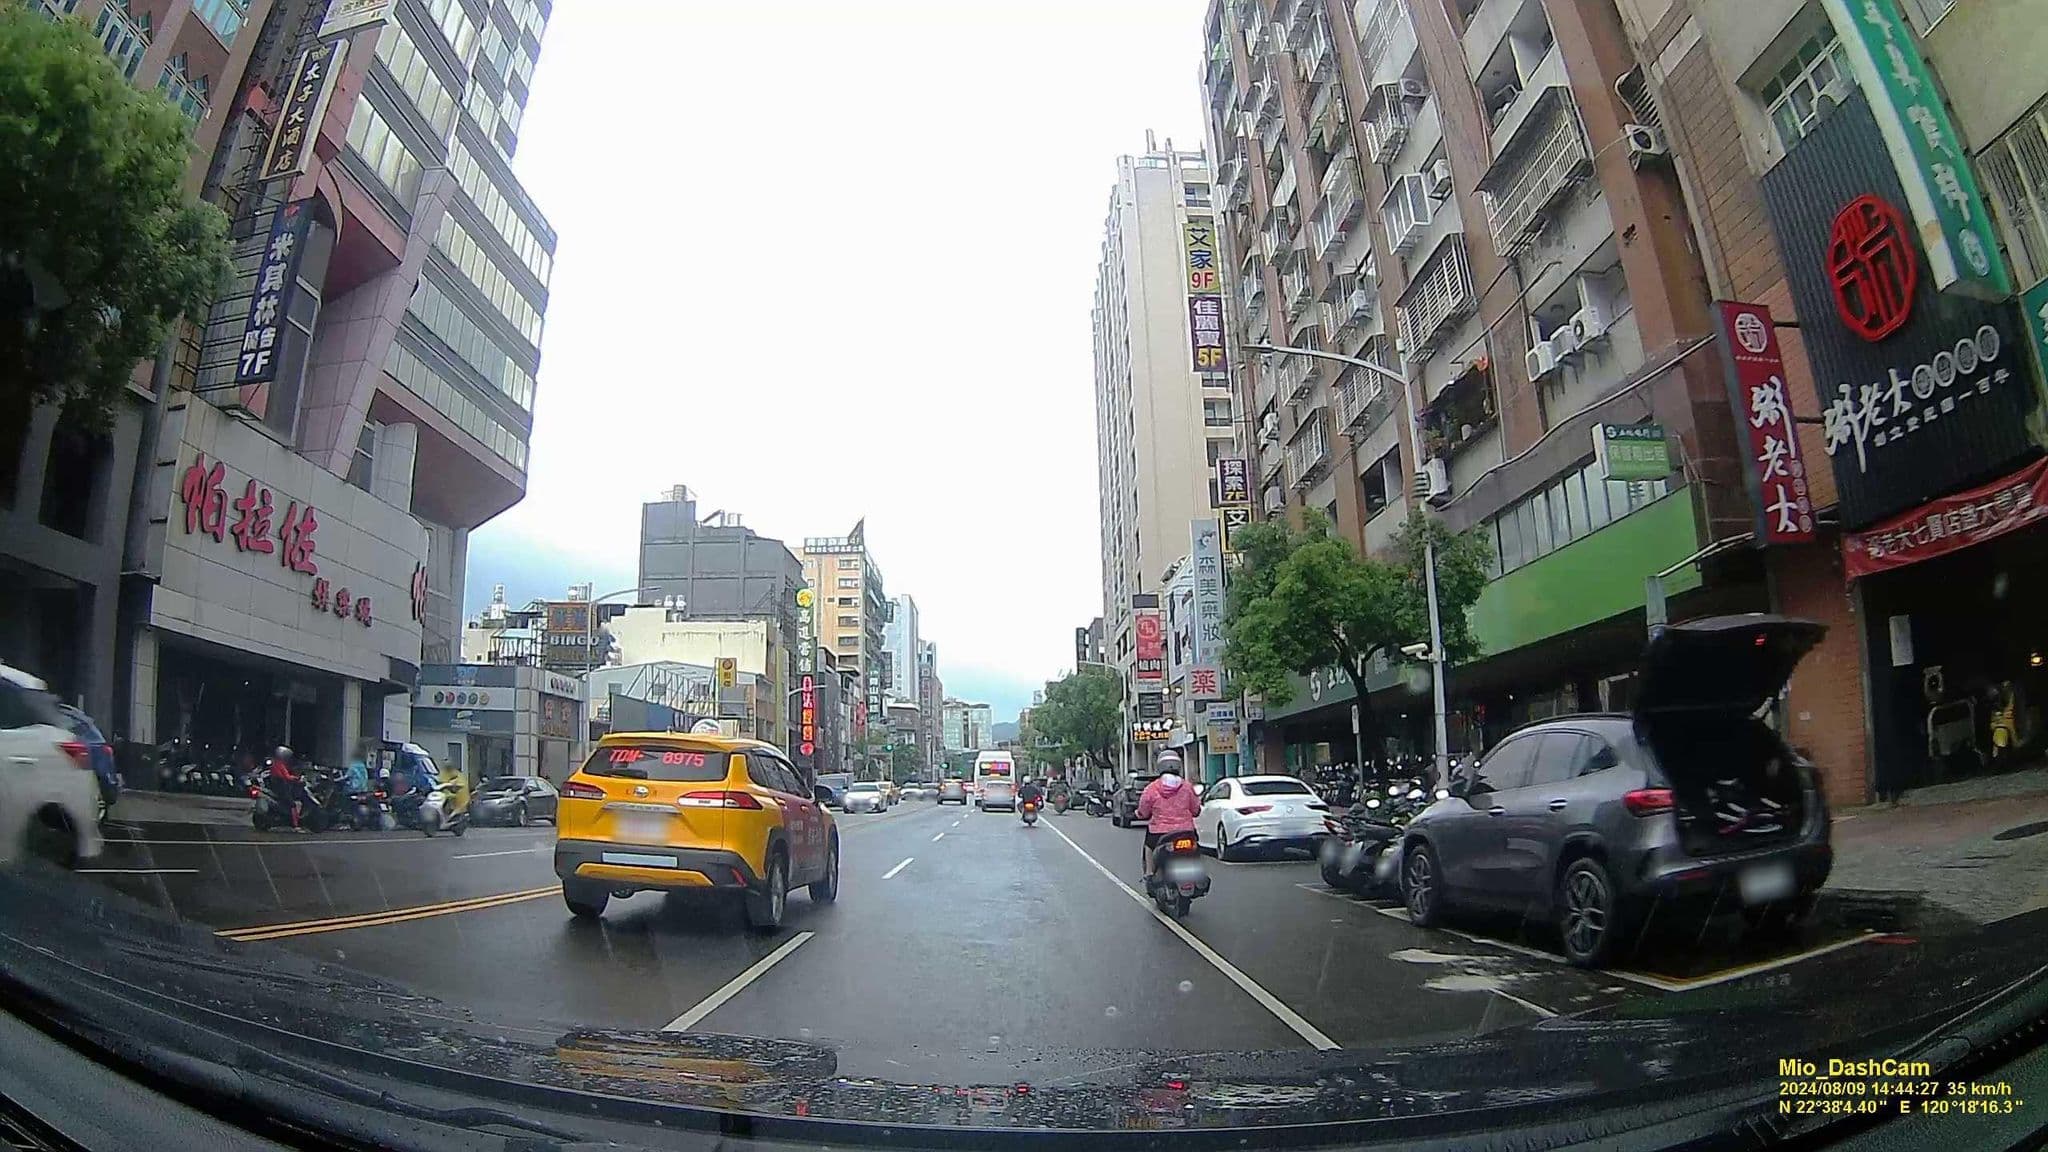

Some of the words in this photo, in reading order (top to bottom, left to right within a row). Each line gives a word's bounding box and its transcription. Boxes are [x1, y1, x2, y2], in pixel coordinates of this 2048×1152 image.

[1187, 227, 1213, 269] 艾家
[1191, 271, 1214, 289] 9F
[241, 350, 272, 376] 7F
[1197, 348, 1222, 367] 5F
[1223, 460, 1244, 491] 探索
